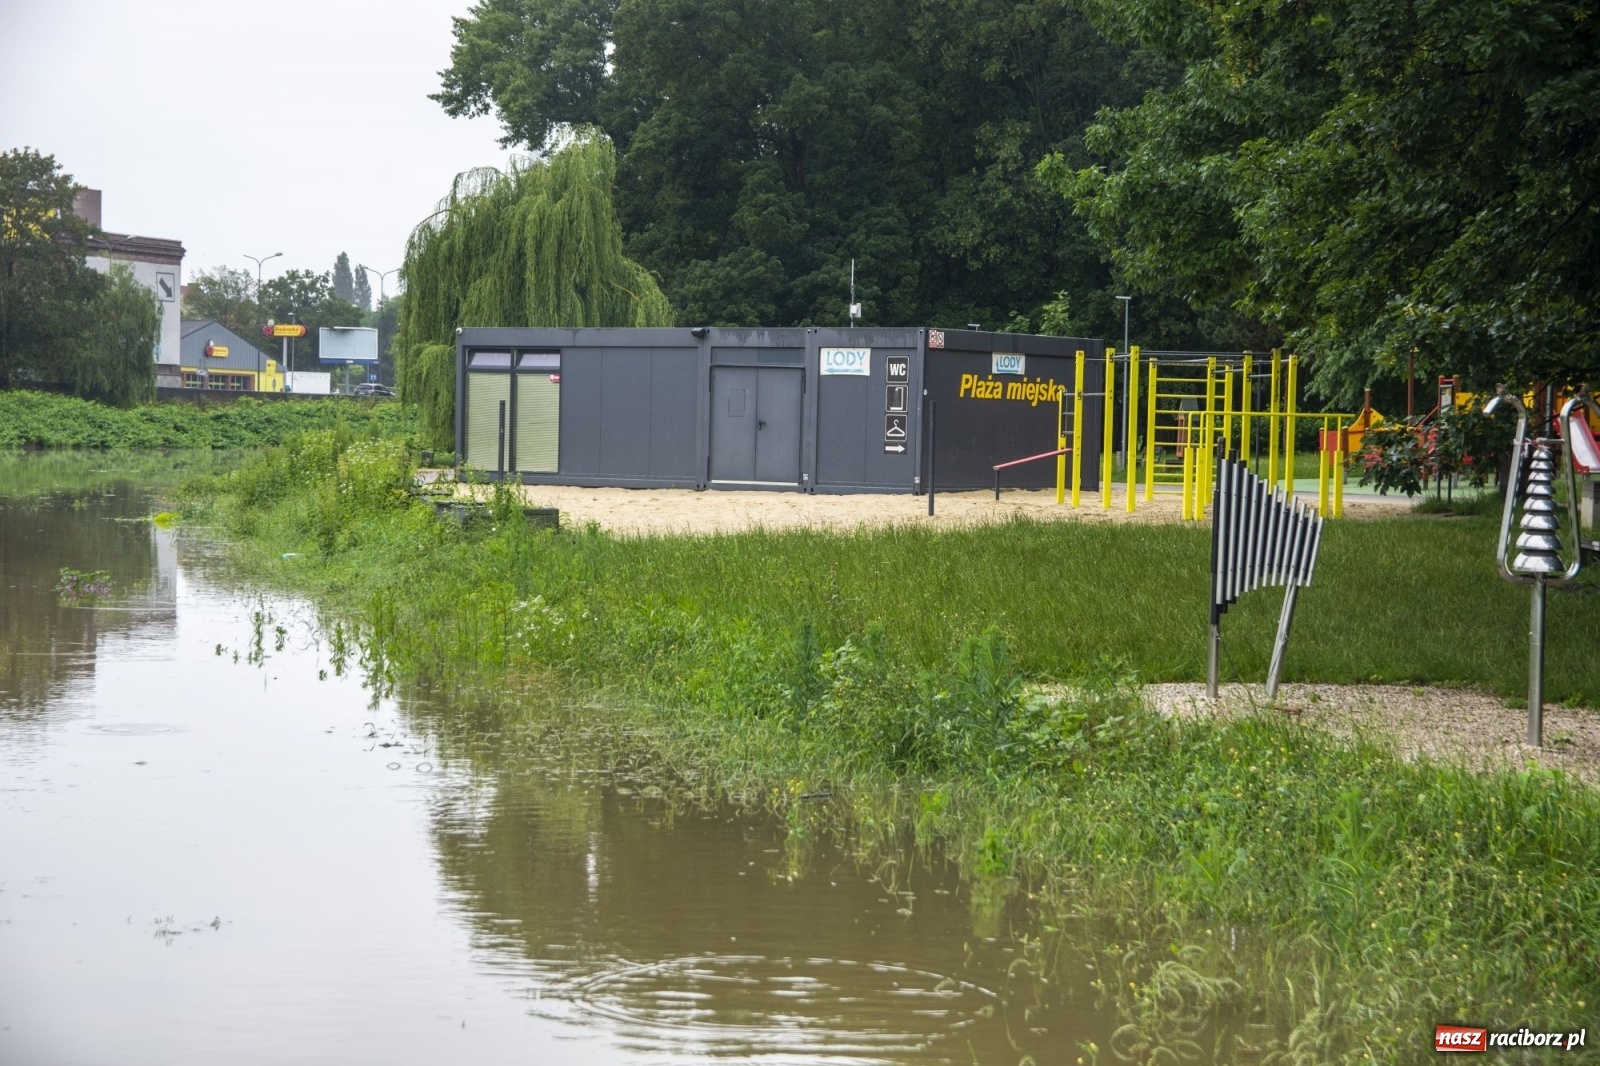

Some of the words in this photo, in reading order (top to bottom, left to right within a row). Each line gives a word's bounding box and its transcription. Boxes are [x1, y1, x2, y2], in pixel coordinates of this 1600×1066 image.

[826, 351, 866, 366] LODY
[1000, 356, 1021, 368] LODY
[889, 364, 906, 376] WC
[959, 373, 1003, 399] Plaża
